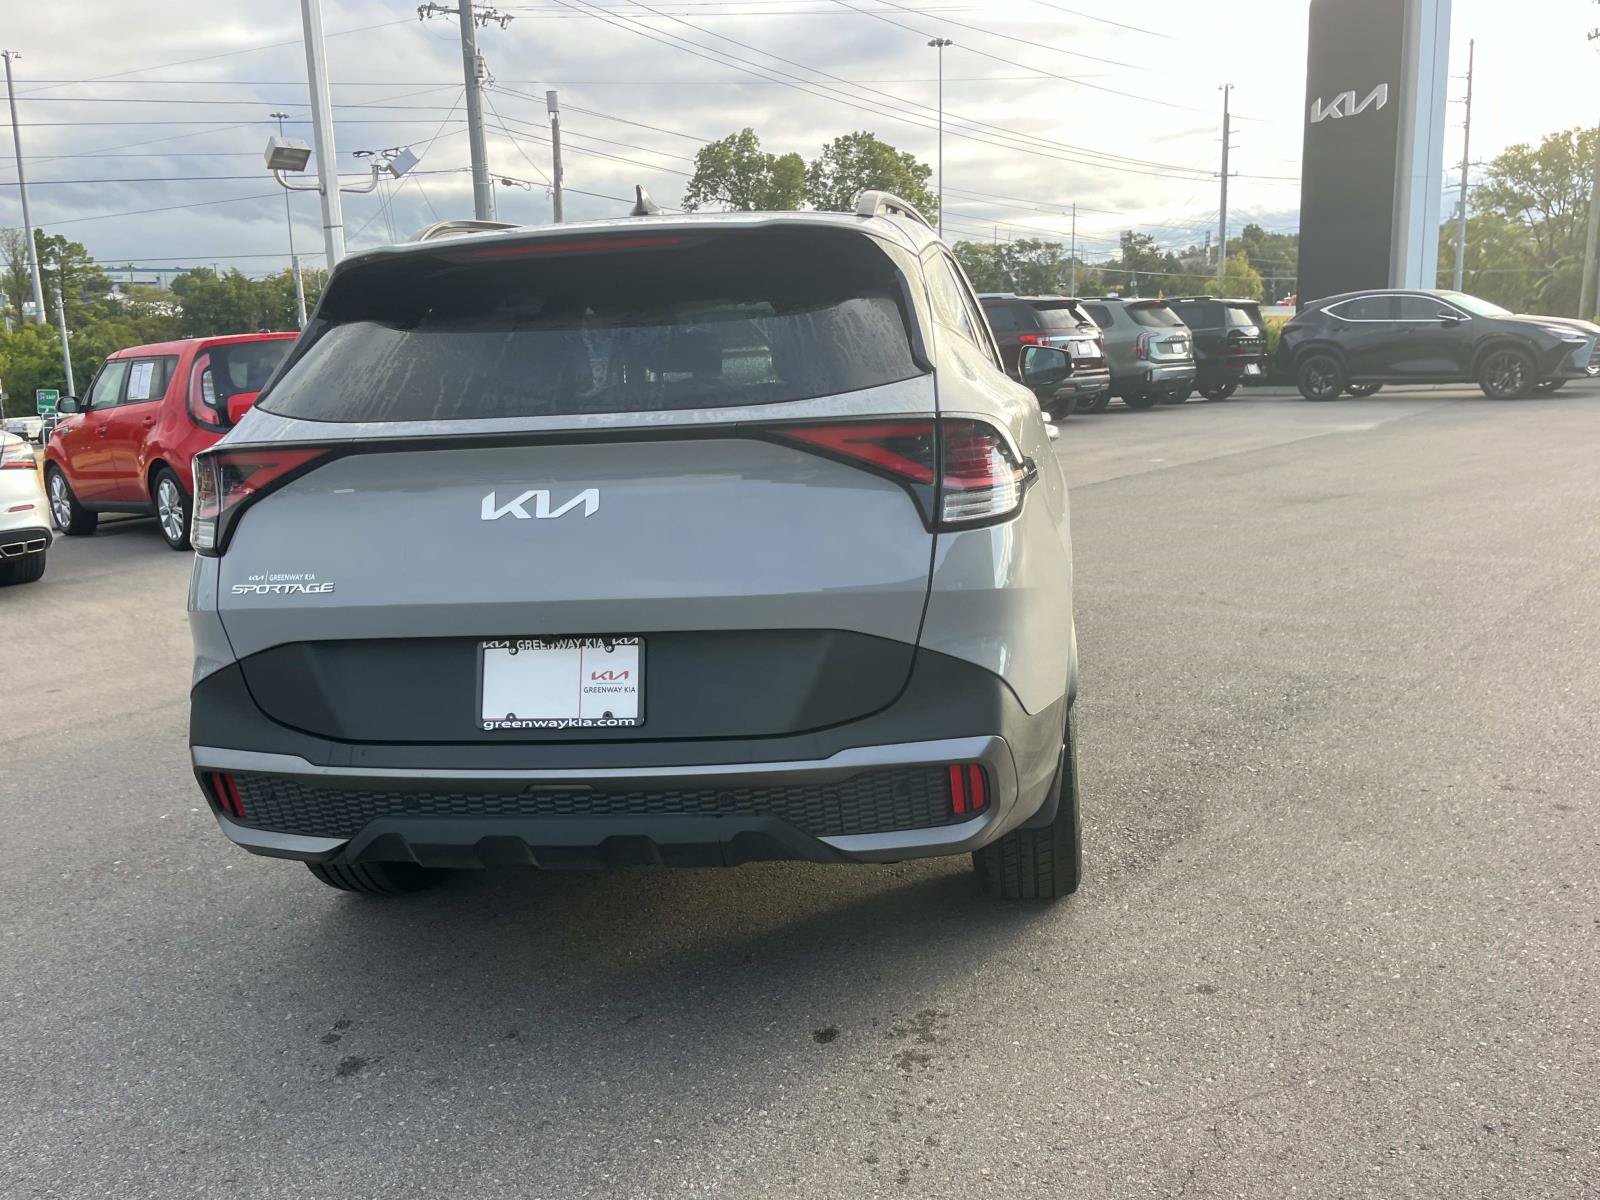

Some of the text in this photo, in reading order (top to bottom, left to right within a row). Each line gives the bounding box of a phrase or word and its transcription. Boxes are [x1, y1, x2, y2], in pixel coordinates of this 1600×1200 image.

[1311, 83, 1388, 123] KIA
[481, 488, 600, 520] KIA
[231, 582, 335, 595] SPORTAGE
[585, 637, 605, 649] KIA
[583, 686, 622, 694] GREENWAY
[483, 718, 635, 730] greenwaykia.com
